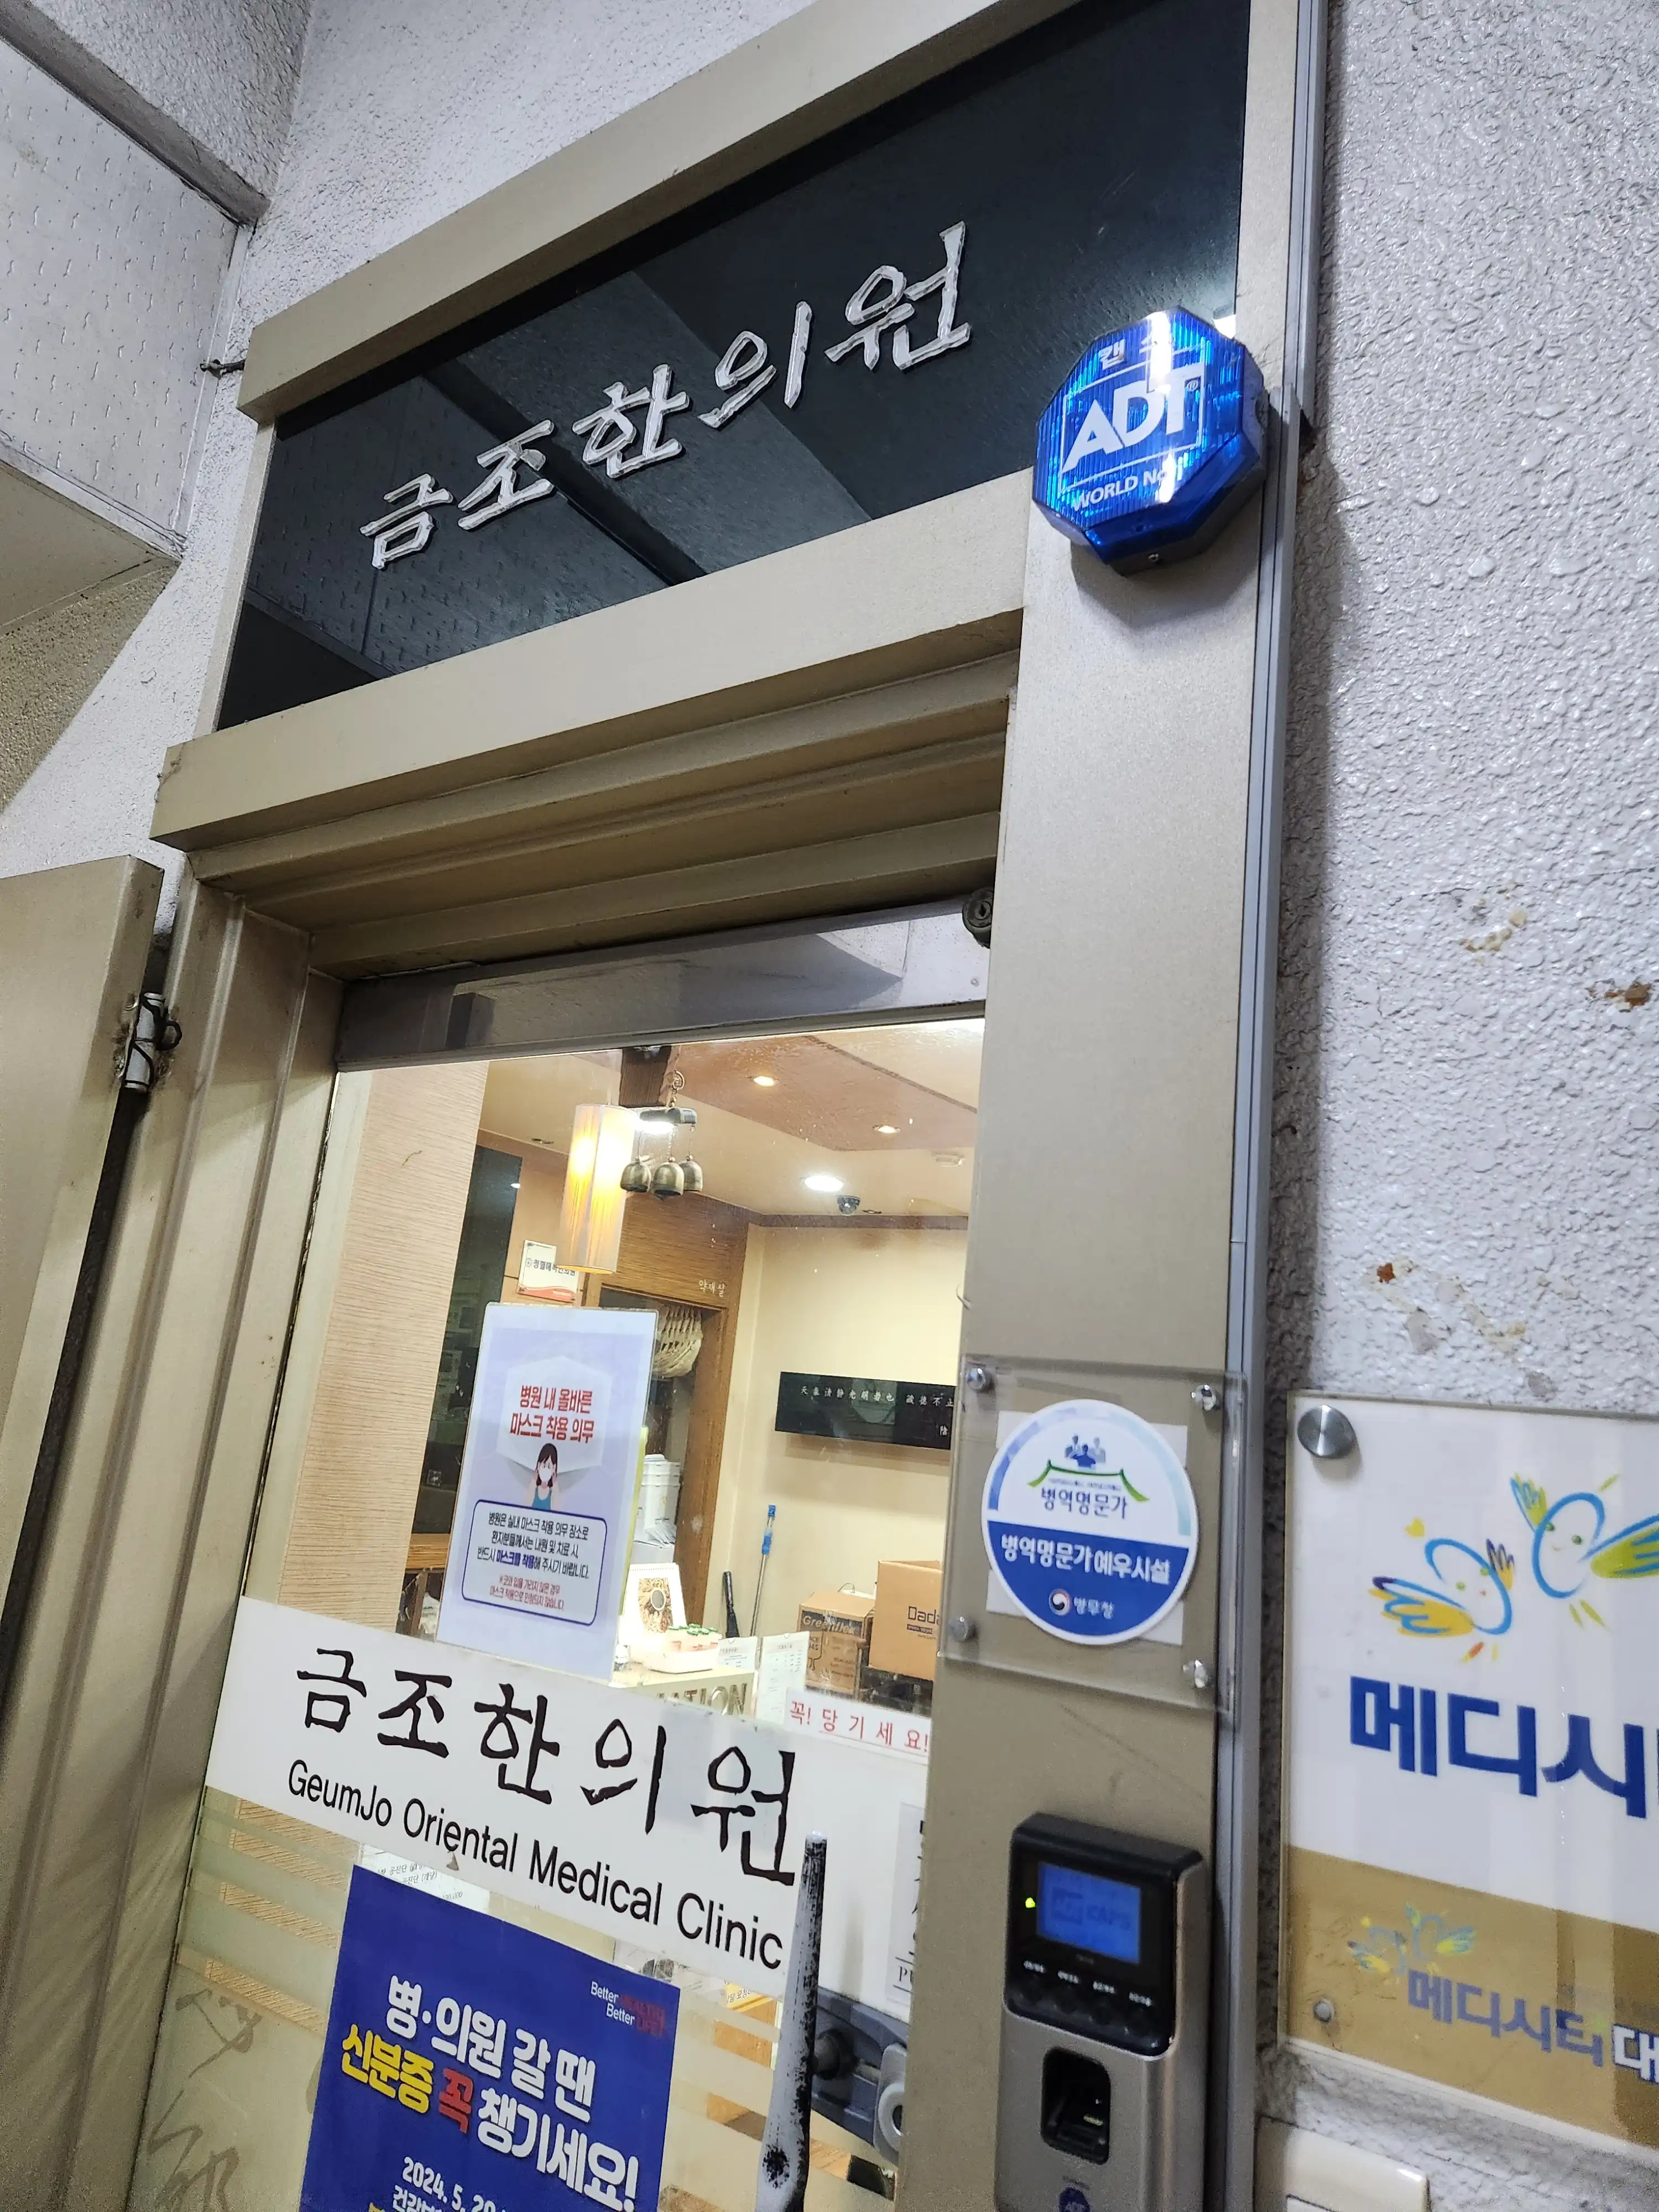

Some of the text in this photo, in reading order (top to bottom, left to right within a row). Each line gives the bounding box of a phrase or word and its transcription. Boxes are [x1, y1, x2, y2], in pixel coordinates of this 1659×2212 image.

[359, 221, 969, 570] 금조한의원
[1062, 362, 1204, 473] ADT
[1074, 476, 1139, 512] WORLD
[520, 1384, 593, 1414] 병원 내 올바른
[509, 1412, 595, 1444] 마스크 착용 의무
[1041, 1486, 1128, 1520] 병역명문가
[488, 1511, 589, 1541] 병원은 실내 마스크 착용 의무 장소로
[477, 1546, 496, 1562] 반드시
[495, 1550, 521, 1567] 마스크를
[521, 1554, 542, 1571] 착용해
[541, 1557, 562, 1574] 주시기
[549, 1540, 556, 1554] 및
[556, 1541, 571, 1557] 치료
[790, 1700, 811, 1725] 꼭!
[1349, 1675, 1659, 1820] 메디시
[296, 1647, 796, 1887] 금조한의원
[288, 1759, 784, 1971] GeumJo Oriental Medical Clinic
[389, 1864, 408, 1875] 공진단
[590, 1980, 619, 2004] Better
[606, 2002, 635, 2026] Better
[510, 2028, 551, 2100] 갈
[554, 2048, 597, 2124] 땐
[341, 2023, 640, 2212] 신분증 꼭 챙기세요!
[402, 2156, 447, 2204] 2024.
